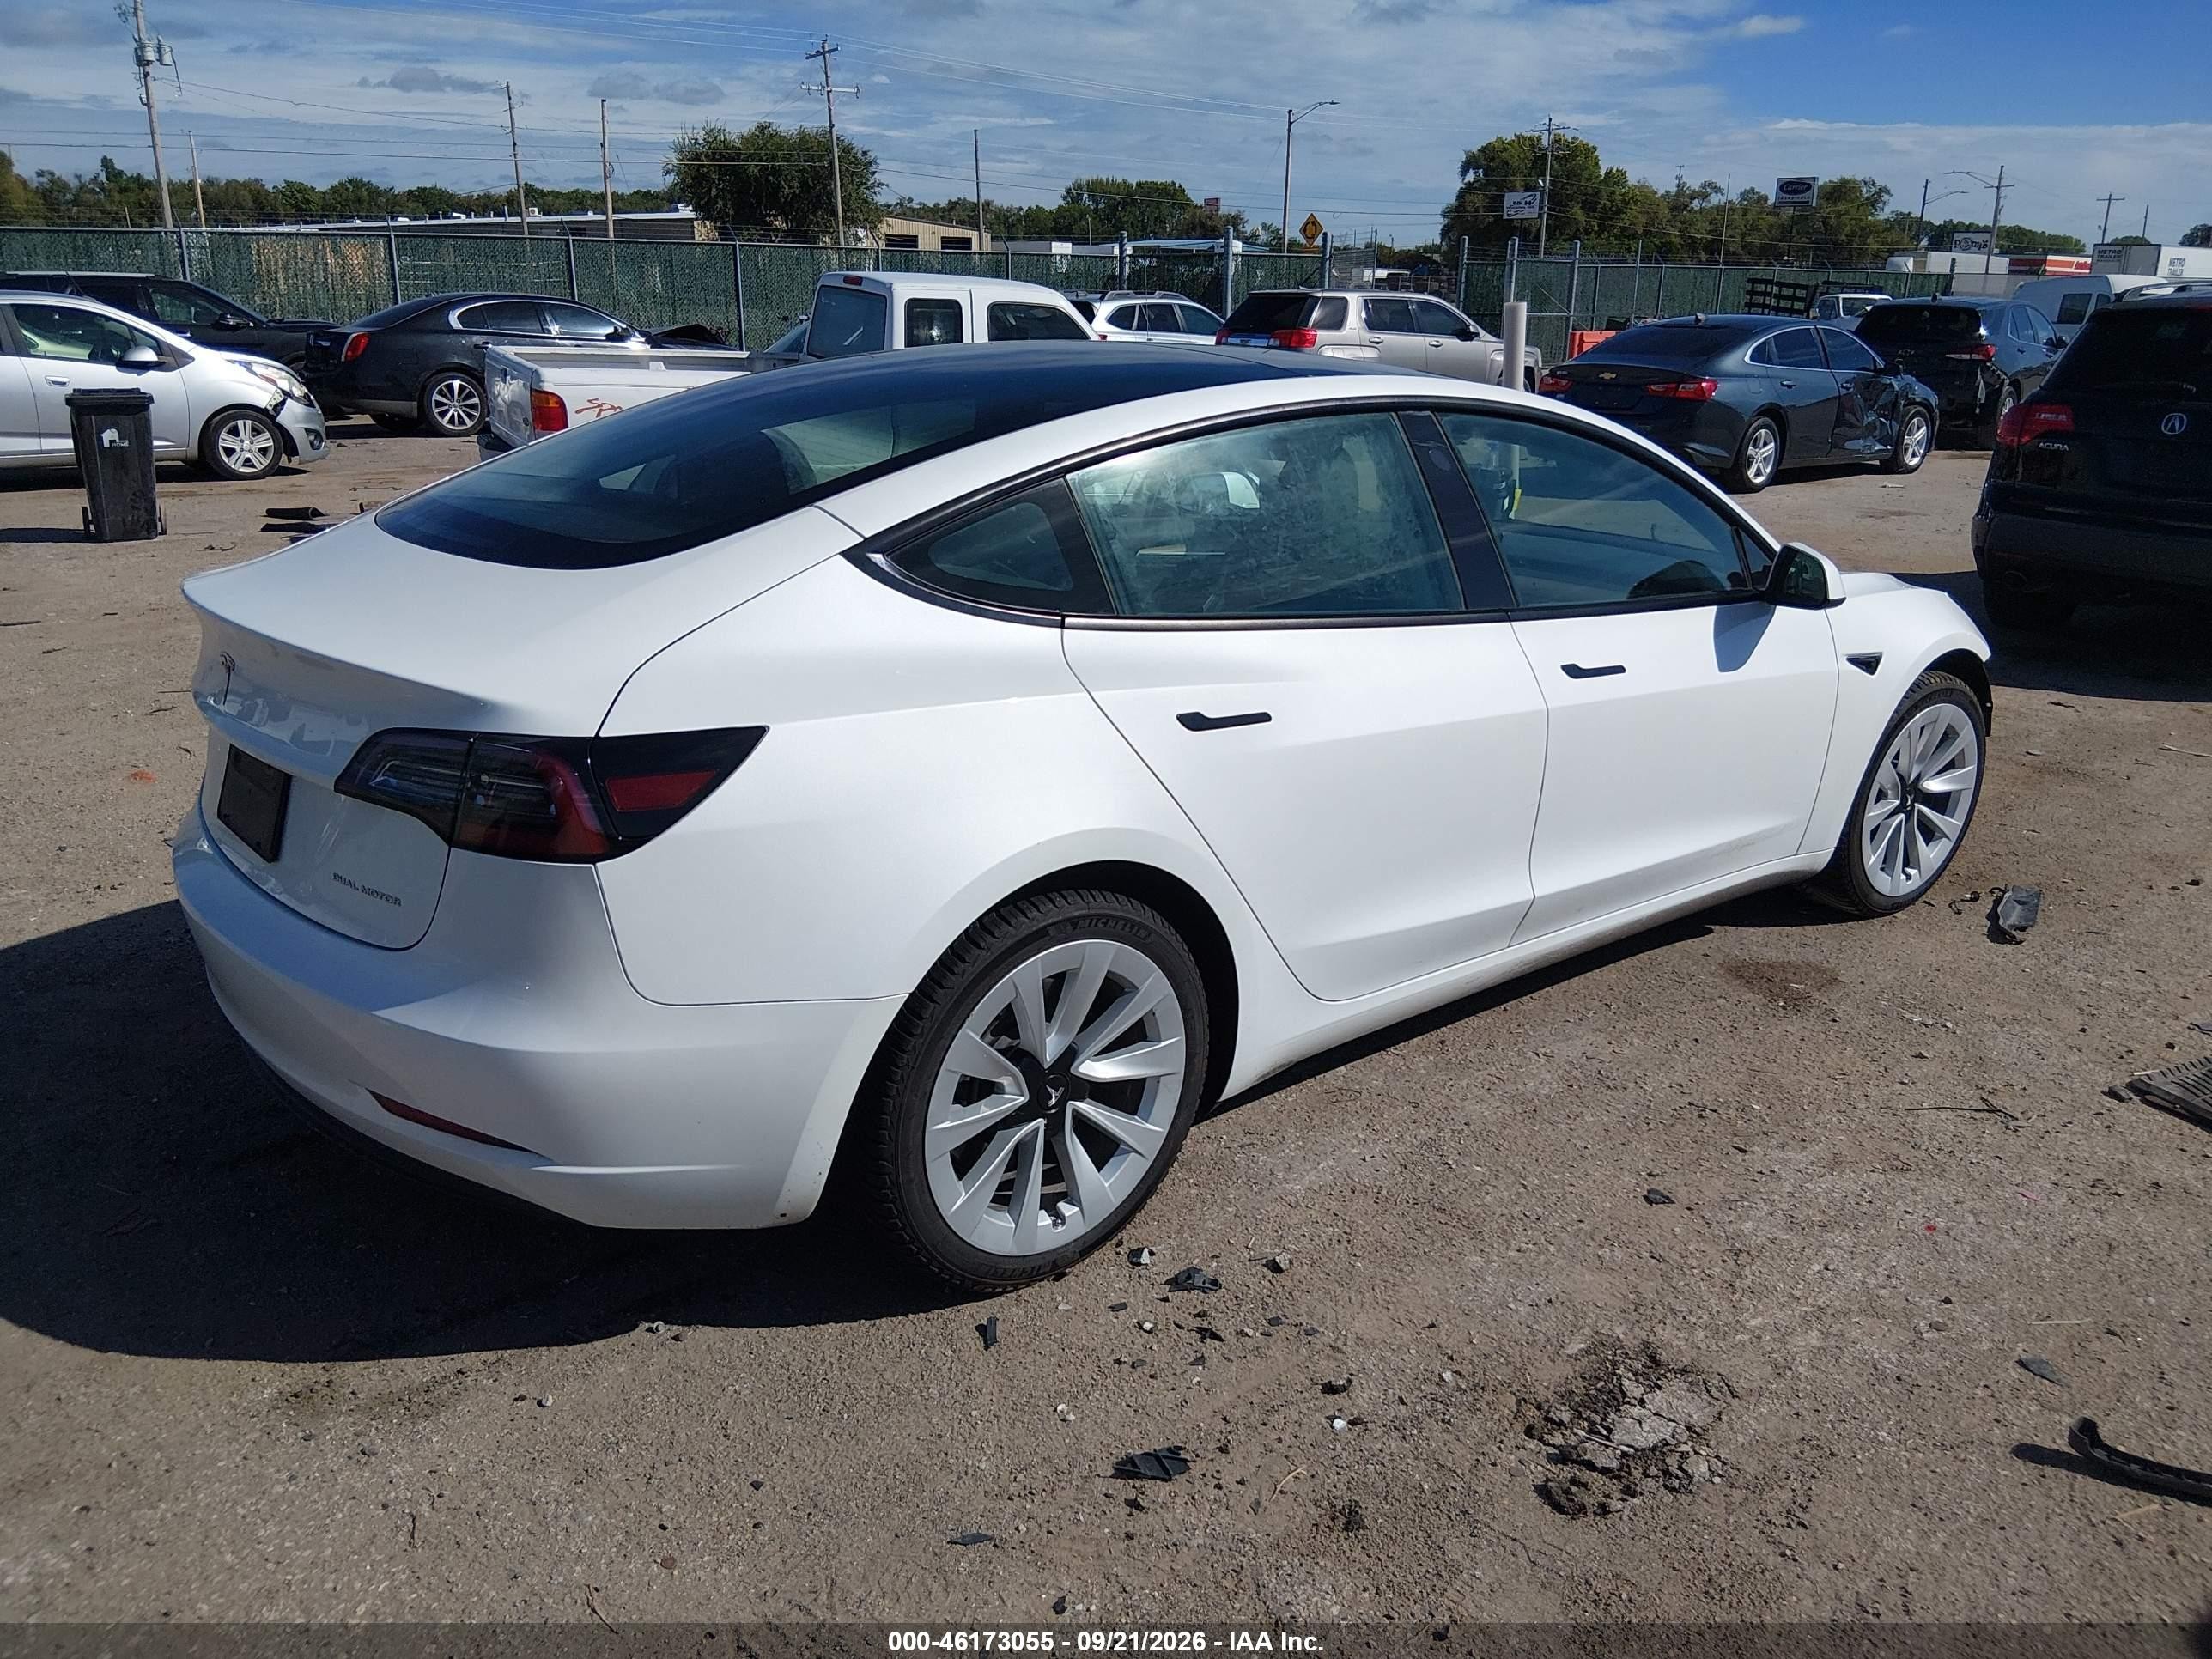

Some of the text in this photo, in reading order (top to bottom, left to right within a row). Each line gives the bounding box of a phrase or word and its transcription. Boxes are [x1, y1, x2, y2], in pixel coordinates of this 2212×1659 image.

[2169, 258, 2185, 267] METRO
[2038, 442, 2069, 452] ACURA
[332, 872, 402, 907] DUAL MOTOR
[1076, 917, 1151, 941] MICHELIN
